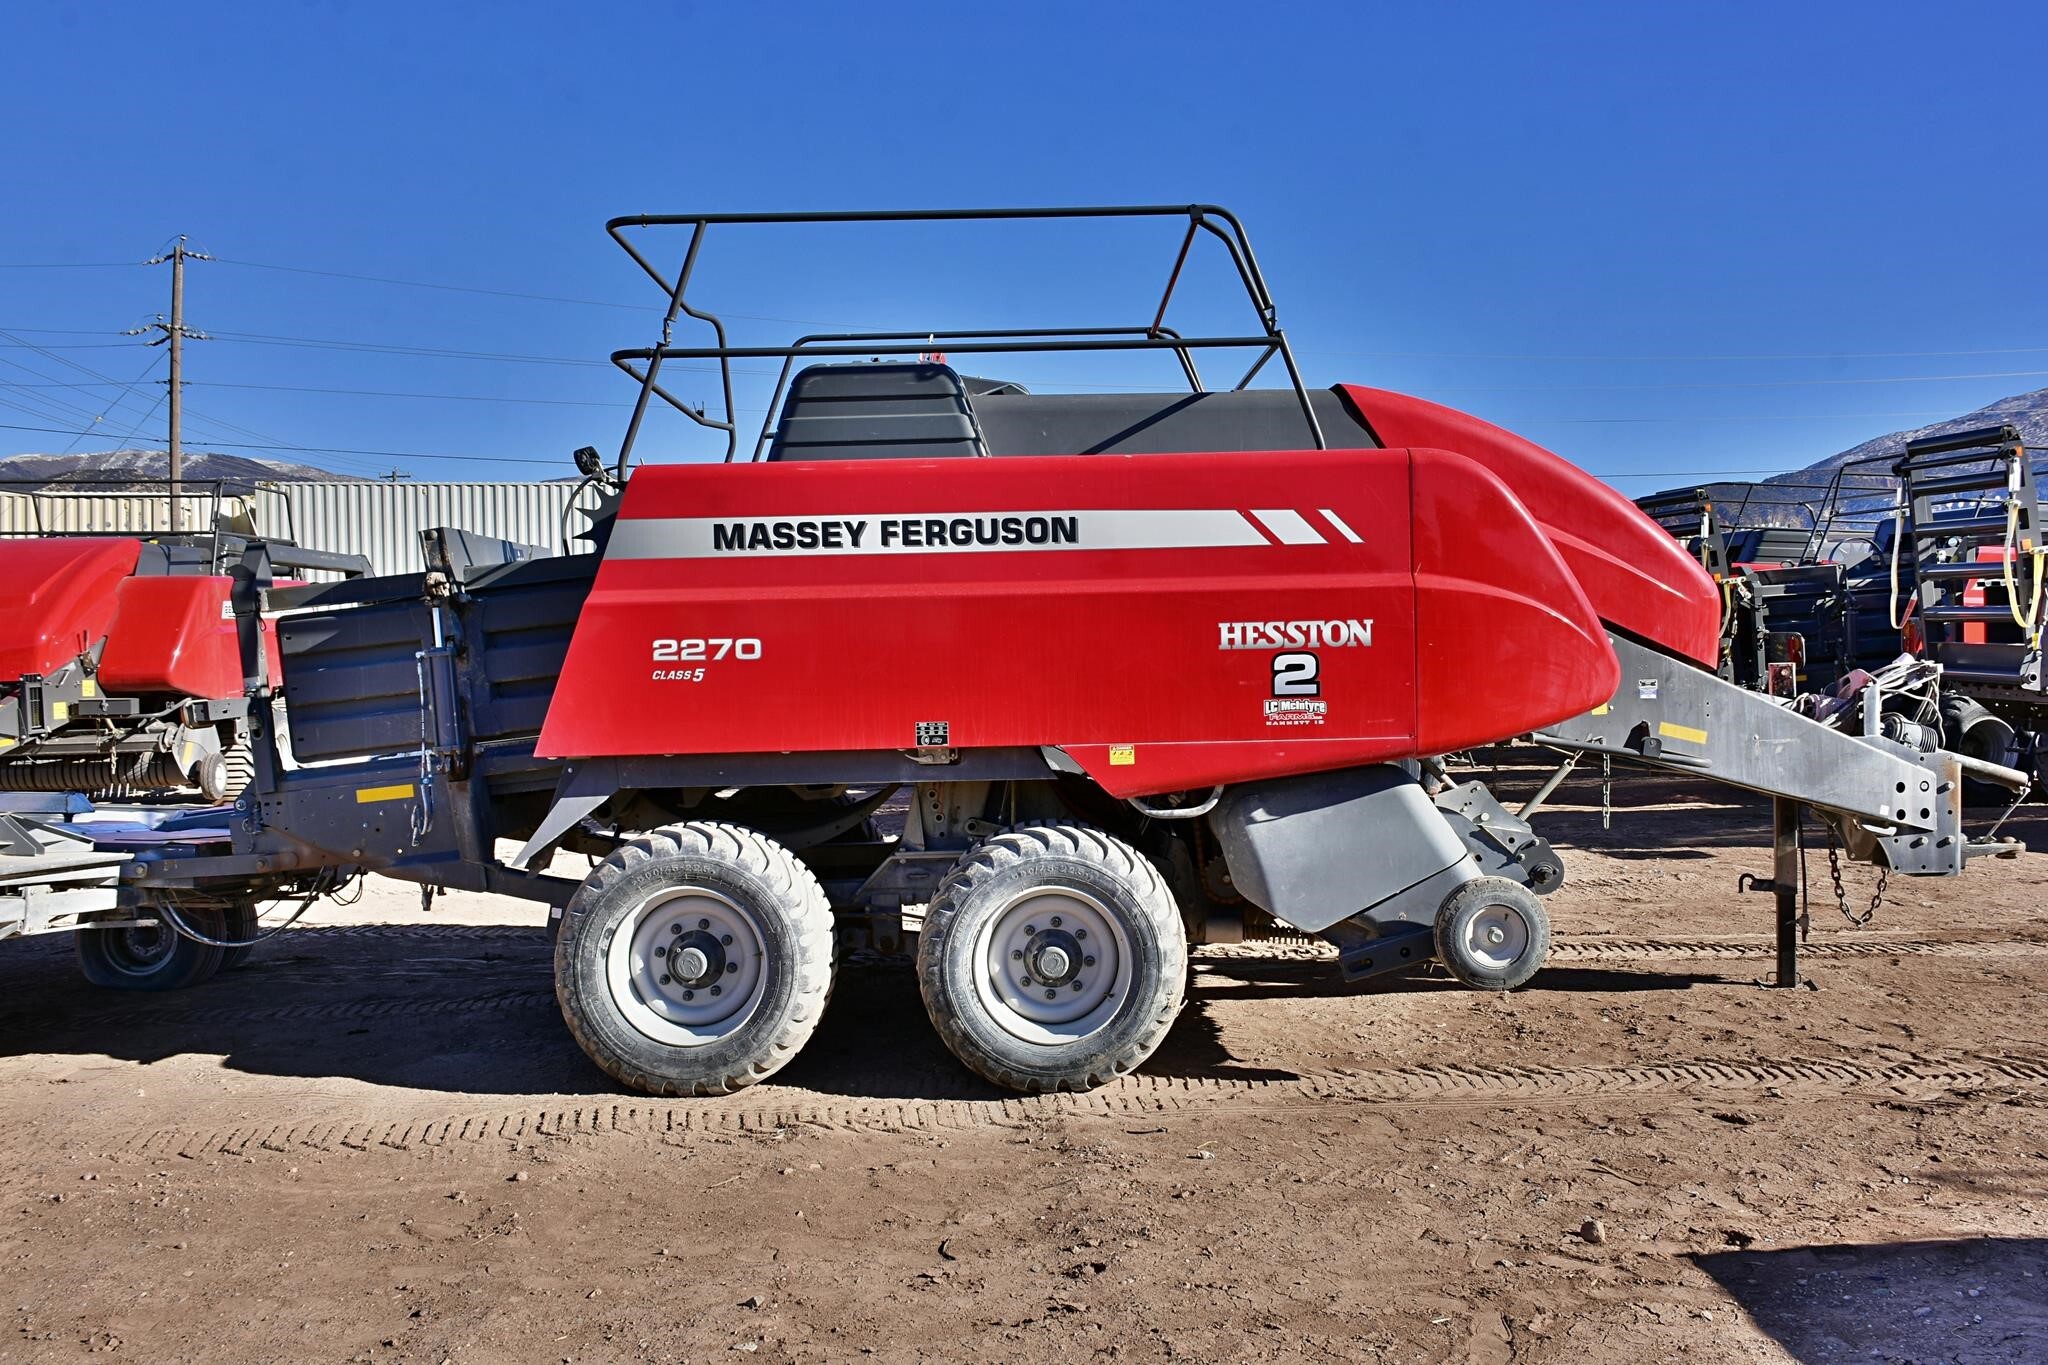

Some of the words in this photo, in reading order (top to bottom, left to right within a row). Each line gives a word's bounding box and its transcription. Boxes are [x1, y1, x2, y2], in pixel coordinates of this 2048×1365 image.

[713, 521, 867, 550] MASSEY
[880, 516, 1079, 547] FERGUSON
[1218, 619, 1374, 650] HESSTON
[652, 638, 762, 661] 2270
[652, 670, 692, 680] CLASS
[692, 668, 706, 682] 5
[1272, 652, 1320, 697] 2
[1264, 700, 1279, 715] LC
[1280, 699, 1326, 713] McIntyre
